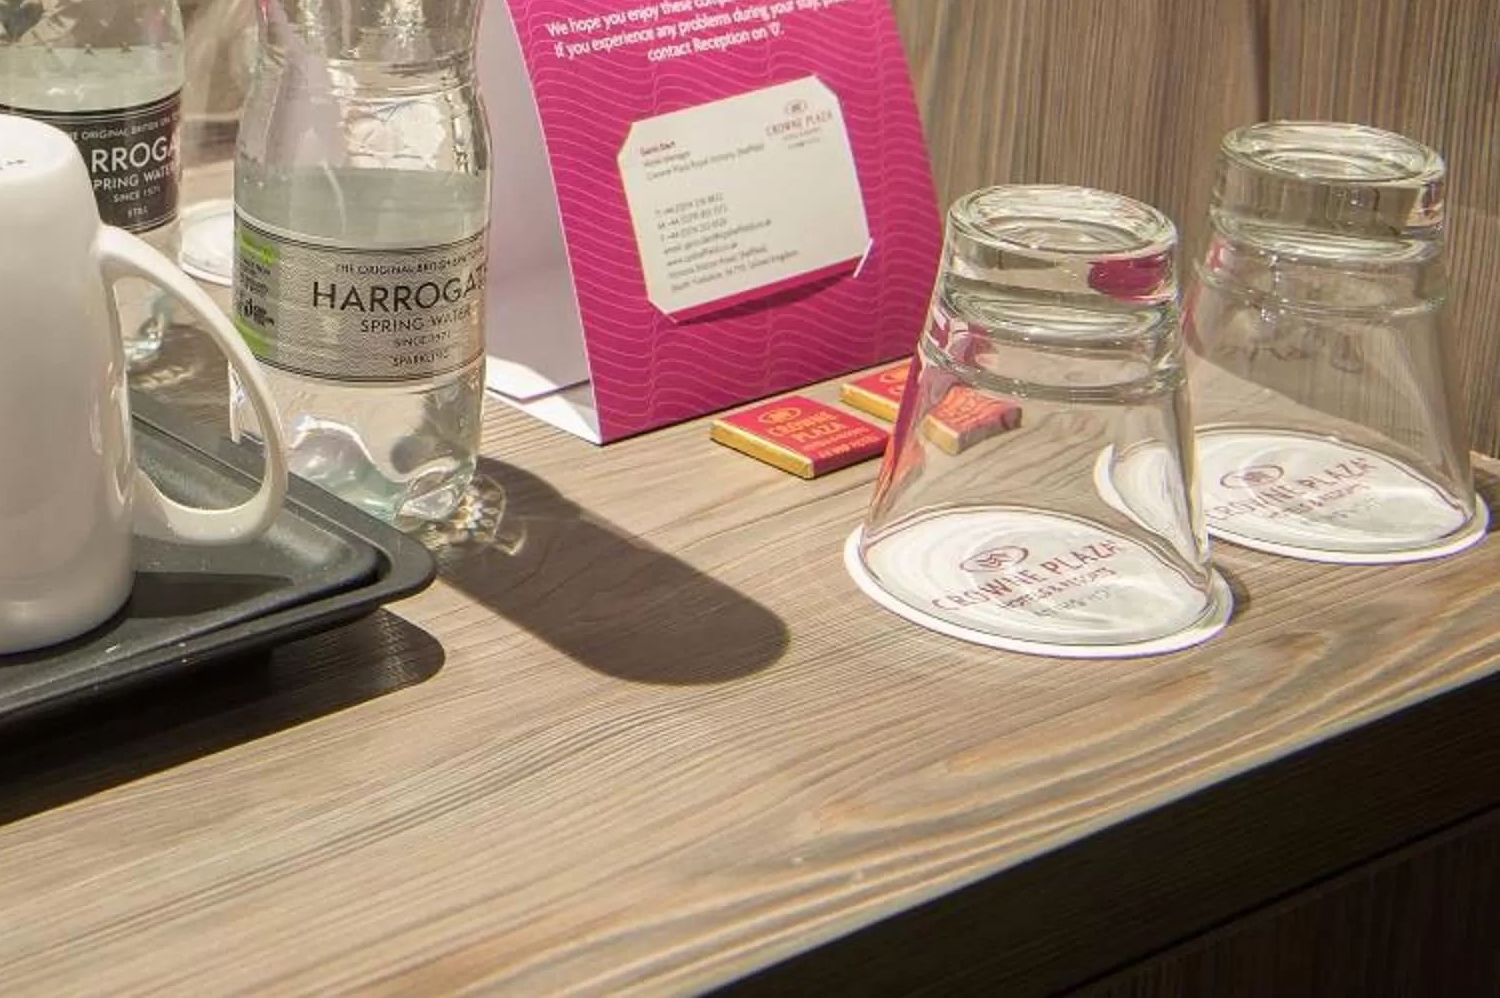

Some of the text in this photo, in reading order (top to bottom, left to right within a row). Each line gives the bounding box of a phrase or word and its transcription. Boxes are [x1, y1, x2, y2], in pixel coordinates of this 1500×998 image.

[546, 21, 569, 37] We
[568, 16, 601, 35] hope
[602, 11, 629, 31] you
[628, 4, 660, 23] enjoy
[565, 42, 591, 60] you
[591, 27, 655, 52] experience
[655, 23, 677, 40] any
[677, 11, 732, 36] problems
[732, 4, 771, 22] during
[770, 0, 795, 18] your
[647, 41, 693, 61] contact
[692, 29, 751, 53] Reception
[751, 26, 768, 41] on
[81, 127, 129, 141] ORIGINAL
[93, 173, 140, 191] PRING
[360, 317, 425, 334] SPRING
[1039, 539, 1119, 576] PLAZA
